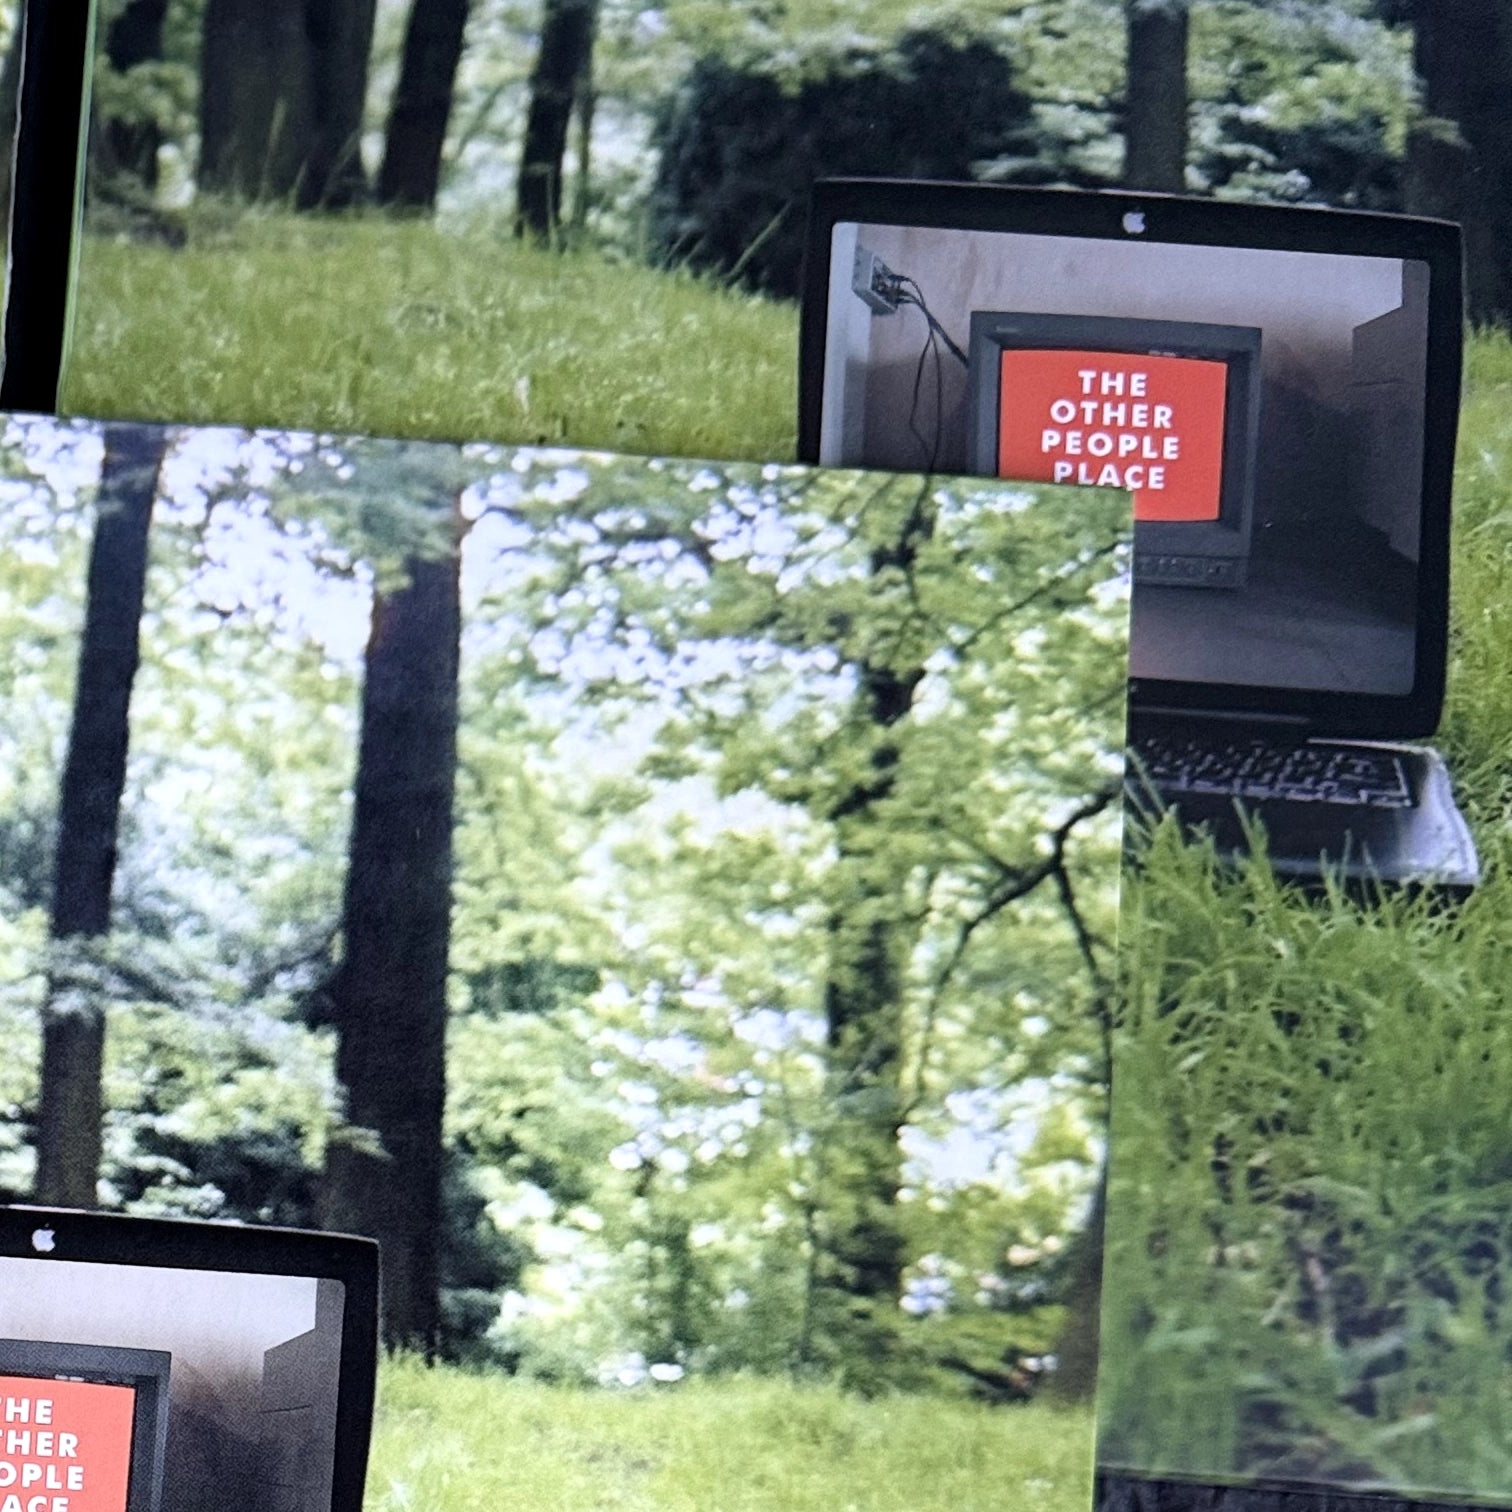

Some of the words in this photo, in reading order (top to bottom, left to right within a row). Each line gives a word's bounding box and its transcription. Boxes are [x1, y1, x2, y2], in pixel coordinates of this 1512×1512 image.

[1077, 370, 1147, 397] THE
[1050, 399, 1173, 429] OTHER
[1041, 429, 1180, 460] PEOPLE
[1054, 461, 1165, 490] PLACE
